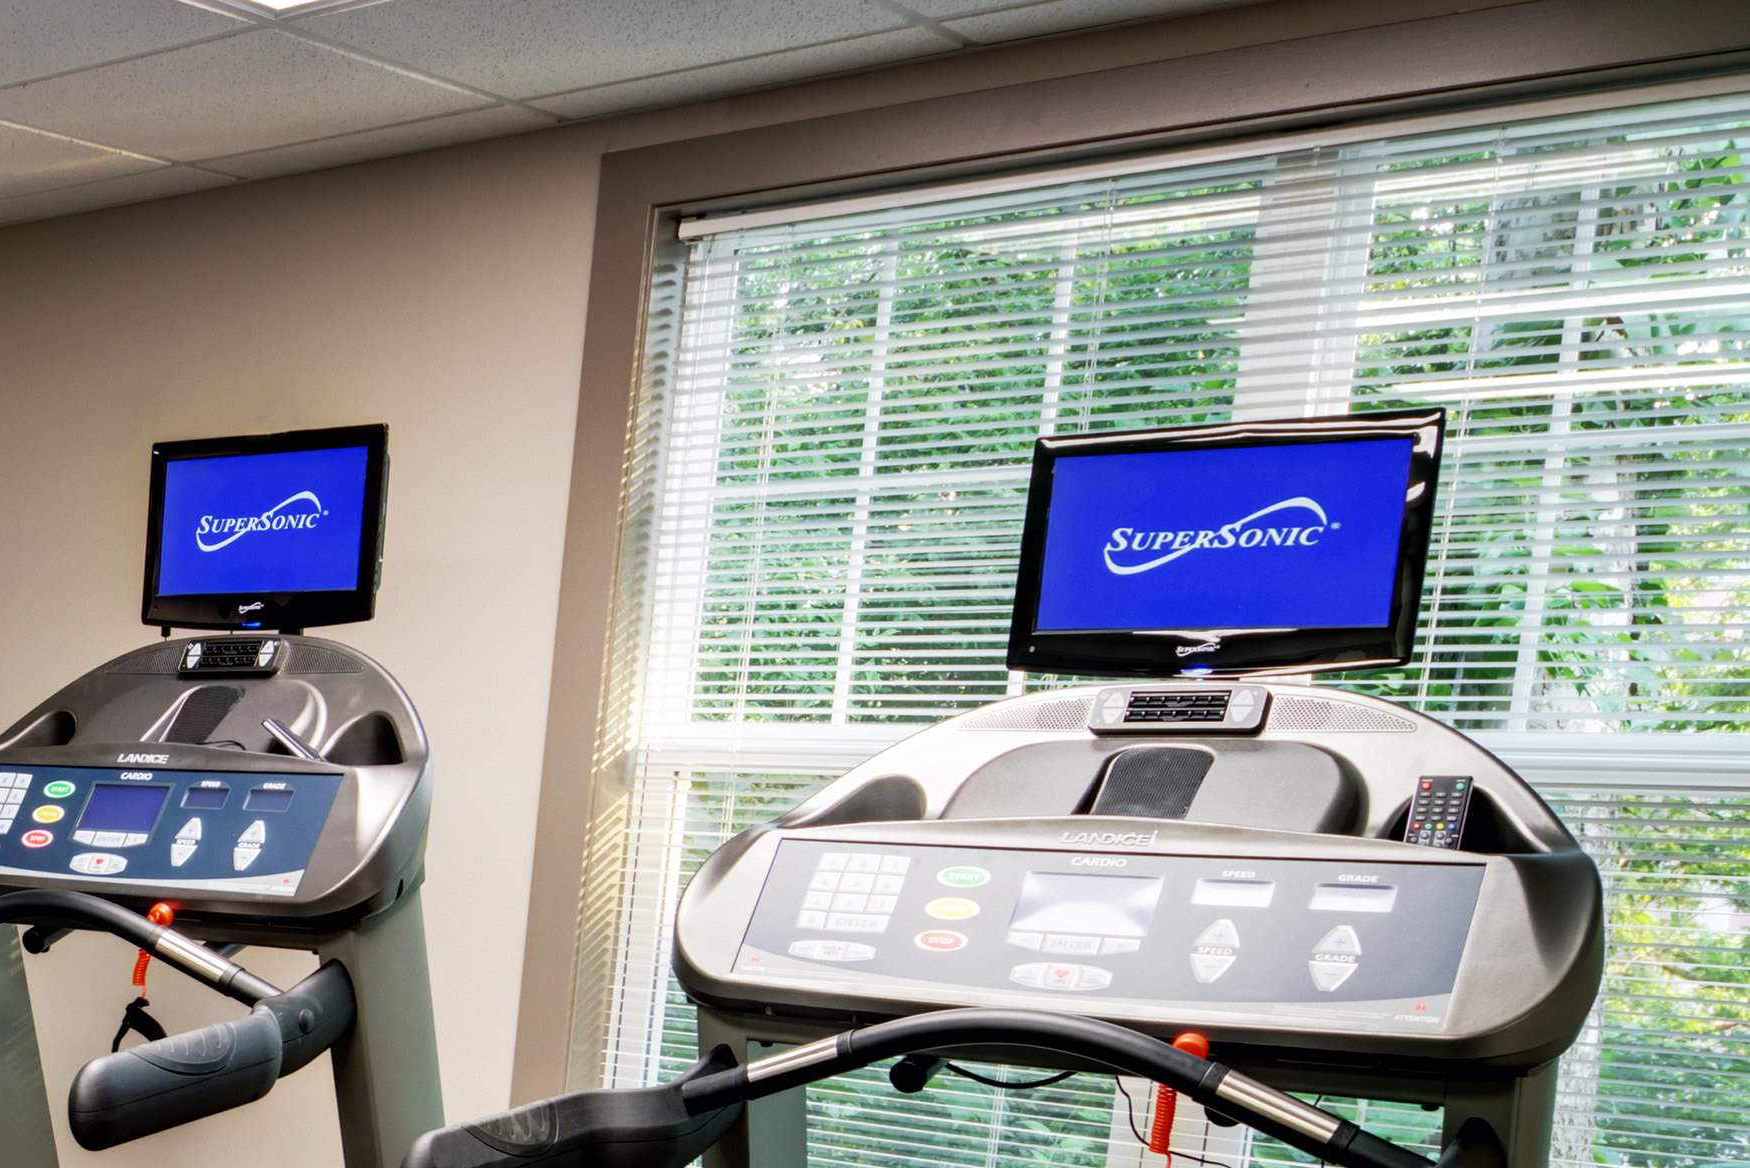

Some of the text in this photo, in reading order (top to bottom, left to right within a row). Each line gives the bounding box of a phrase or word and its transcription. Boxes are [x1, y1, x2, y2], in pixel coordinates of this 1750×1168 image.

[199, 512, 320, 534] SUPERSONIC
[1104, 523, 1325, 551] SUPERSONIC
[117, 753, 169, 765] LANDICE
[1060, 831, 1153, 847] LANDICE
[1071, 856, 1127, 868] CARDIO
[1221, 870, 1256, 878] SPEED
[1338, 874, 1379, 883] GRADE
